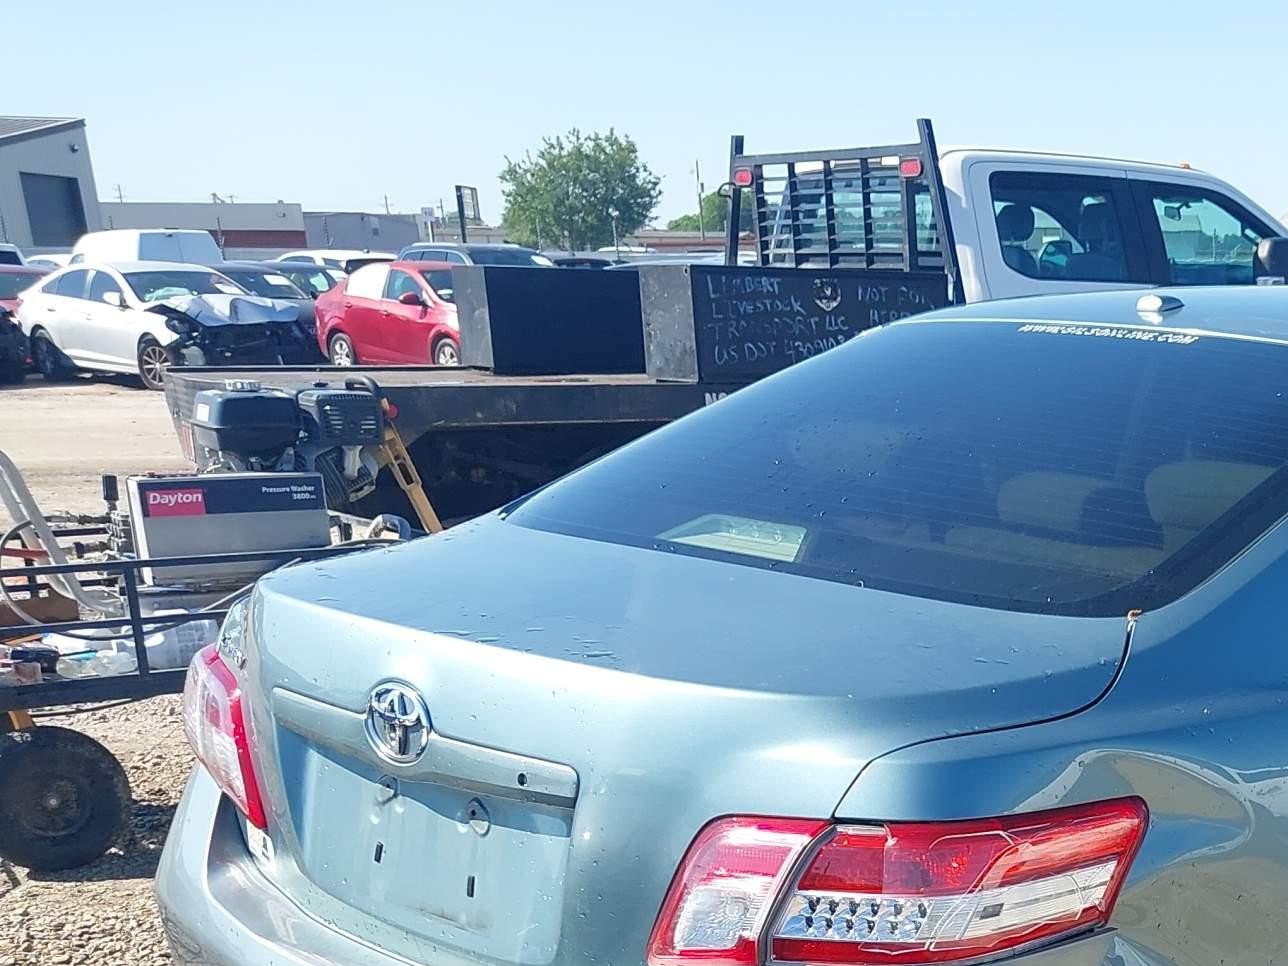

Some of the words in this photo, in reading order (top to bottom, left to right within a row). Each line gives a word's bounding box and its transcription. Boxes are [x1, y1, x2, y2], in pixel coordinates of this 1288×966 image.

[712, 296, 807, 318] LIVESTOCK
[826, 315, 849, 331] LLC
[290, 484, 315, 492] Washer
[149, 492, 202, 507] Dayton
